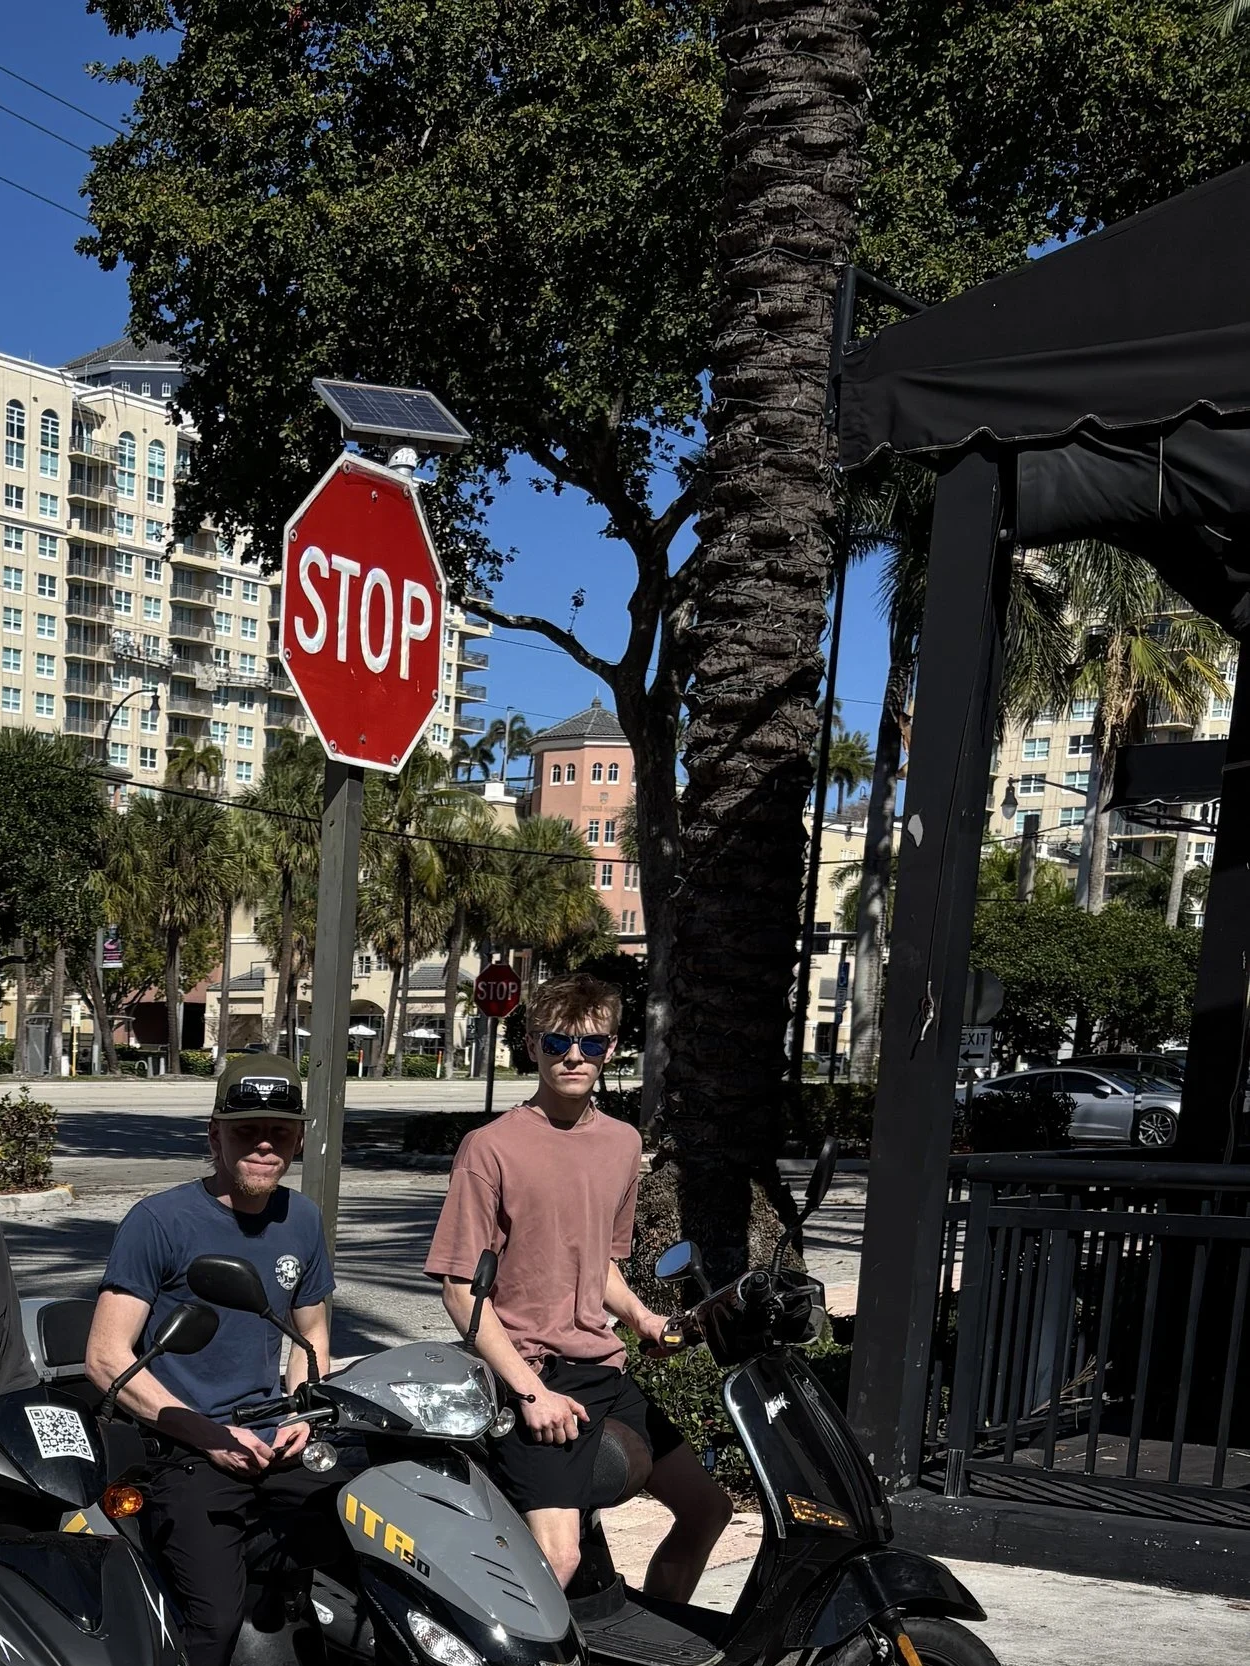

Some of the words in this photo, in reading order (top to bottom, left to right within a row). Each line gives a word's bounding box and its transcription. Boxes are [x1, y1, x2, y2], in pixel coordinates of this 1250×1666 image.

[294, 545, 433, 681] STOP
[477, 981, 519, 1001] STOP
[960, 1032, 988, 1046] EXIT
[402, 1549, 431, 1579] 50
